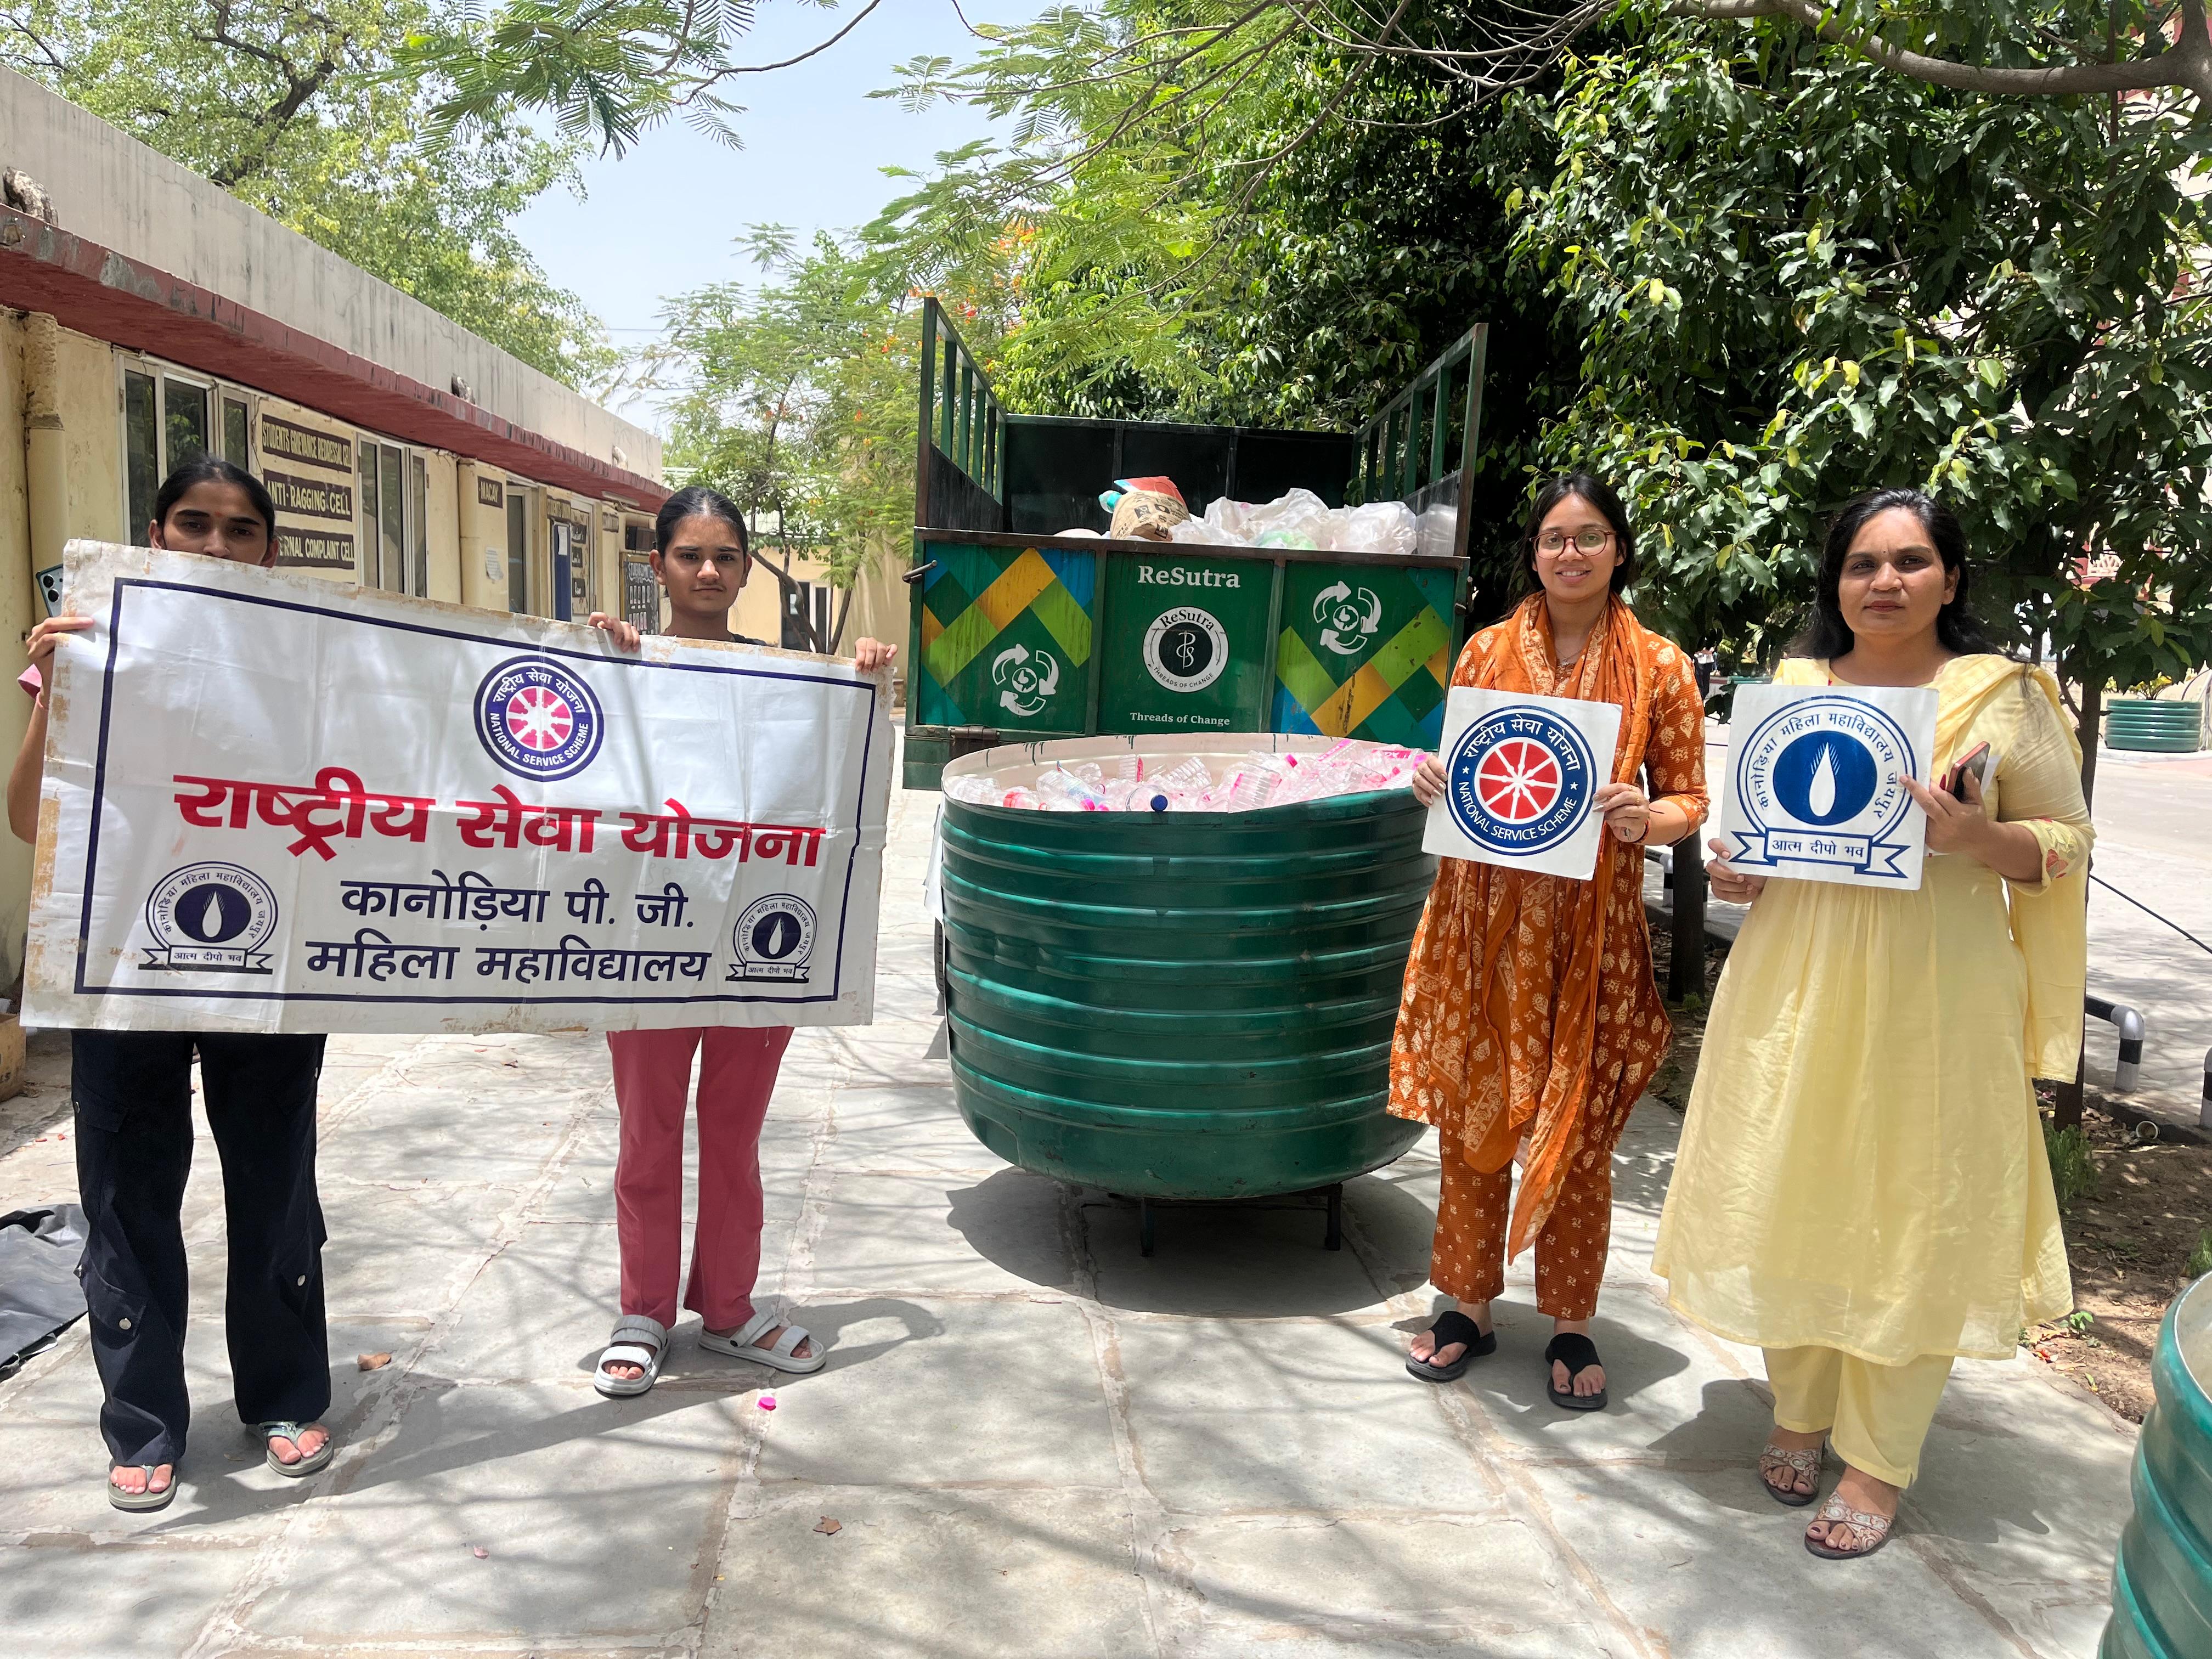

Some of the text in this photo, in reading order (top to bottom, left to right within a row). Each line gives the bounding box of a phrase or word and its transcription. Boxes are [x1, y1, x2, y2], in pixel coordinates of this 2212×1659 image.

[262, 421, 290, 453] STUDENTS
[330, 492, 350, 515] CELL
[305, 538, 339, 560] COMPLAINT
[341, 541, 355, 562] CELL
[1137, 565, 1240, 588] ReSutra
[1159, 609, 1214, 631] ReSutra
[492, 668, 586, 713] राष्ट्रीय सेवा योजना
[1153, 667, 1177, 686] THREADS
[1189, 672, 1214, 687] CHANGE
[490, 713, 589, 766] NATIONAL SERVICE SCHEME
[1130, 712, 1230, 727] Threads of Change
[1463, 714, 1581, 771] राष्ट्रीय सेवा योजना
[1780, 714, 1820, 736] महिला
[1829, 713, 1895, 763] महाविद्यालय
[1873, 771, 1898, 820] जयपुर
[173, 766, 827, 867] राष्ट्रीय सेवा योजना
[1459, 781, 1577, 840] NATIONAL SERVICE SCHEME
[1772, 839, 1864, 857] आत्म दीपो भव
[179, 872, 210, 887] महिला
[215, 872, 263, 905] महाविद्यालय
[248, 910, 265, 939] जयपुर
[340, 870, 694, 932] कानोड़िया पी. जी.
[756, 902, 778, 915] महिला
[798, 932, 811, 955] जयपुर
[174, 952, 196, 960] आत्म
[202, 951, 222, 961] दीपो
[305, 928, 712, 984] महिला महाविद्यालय
